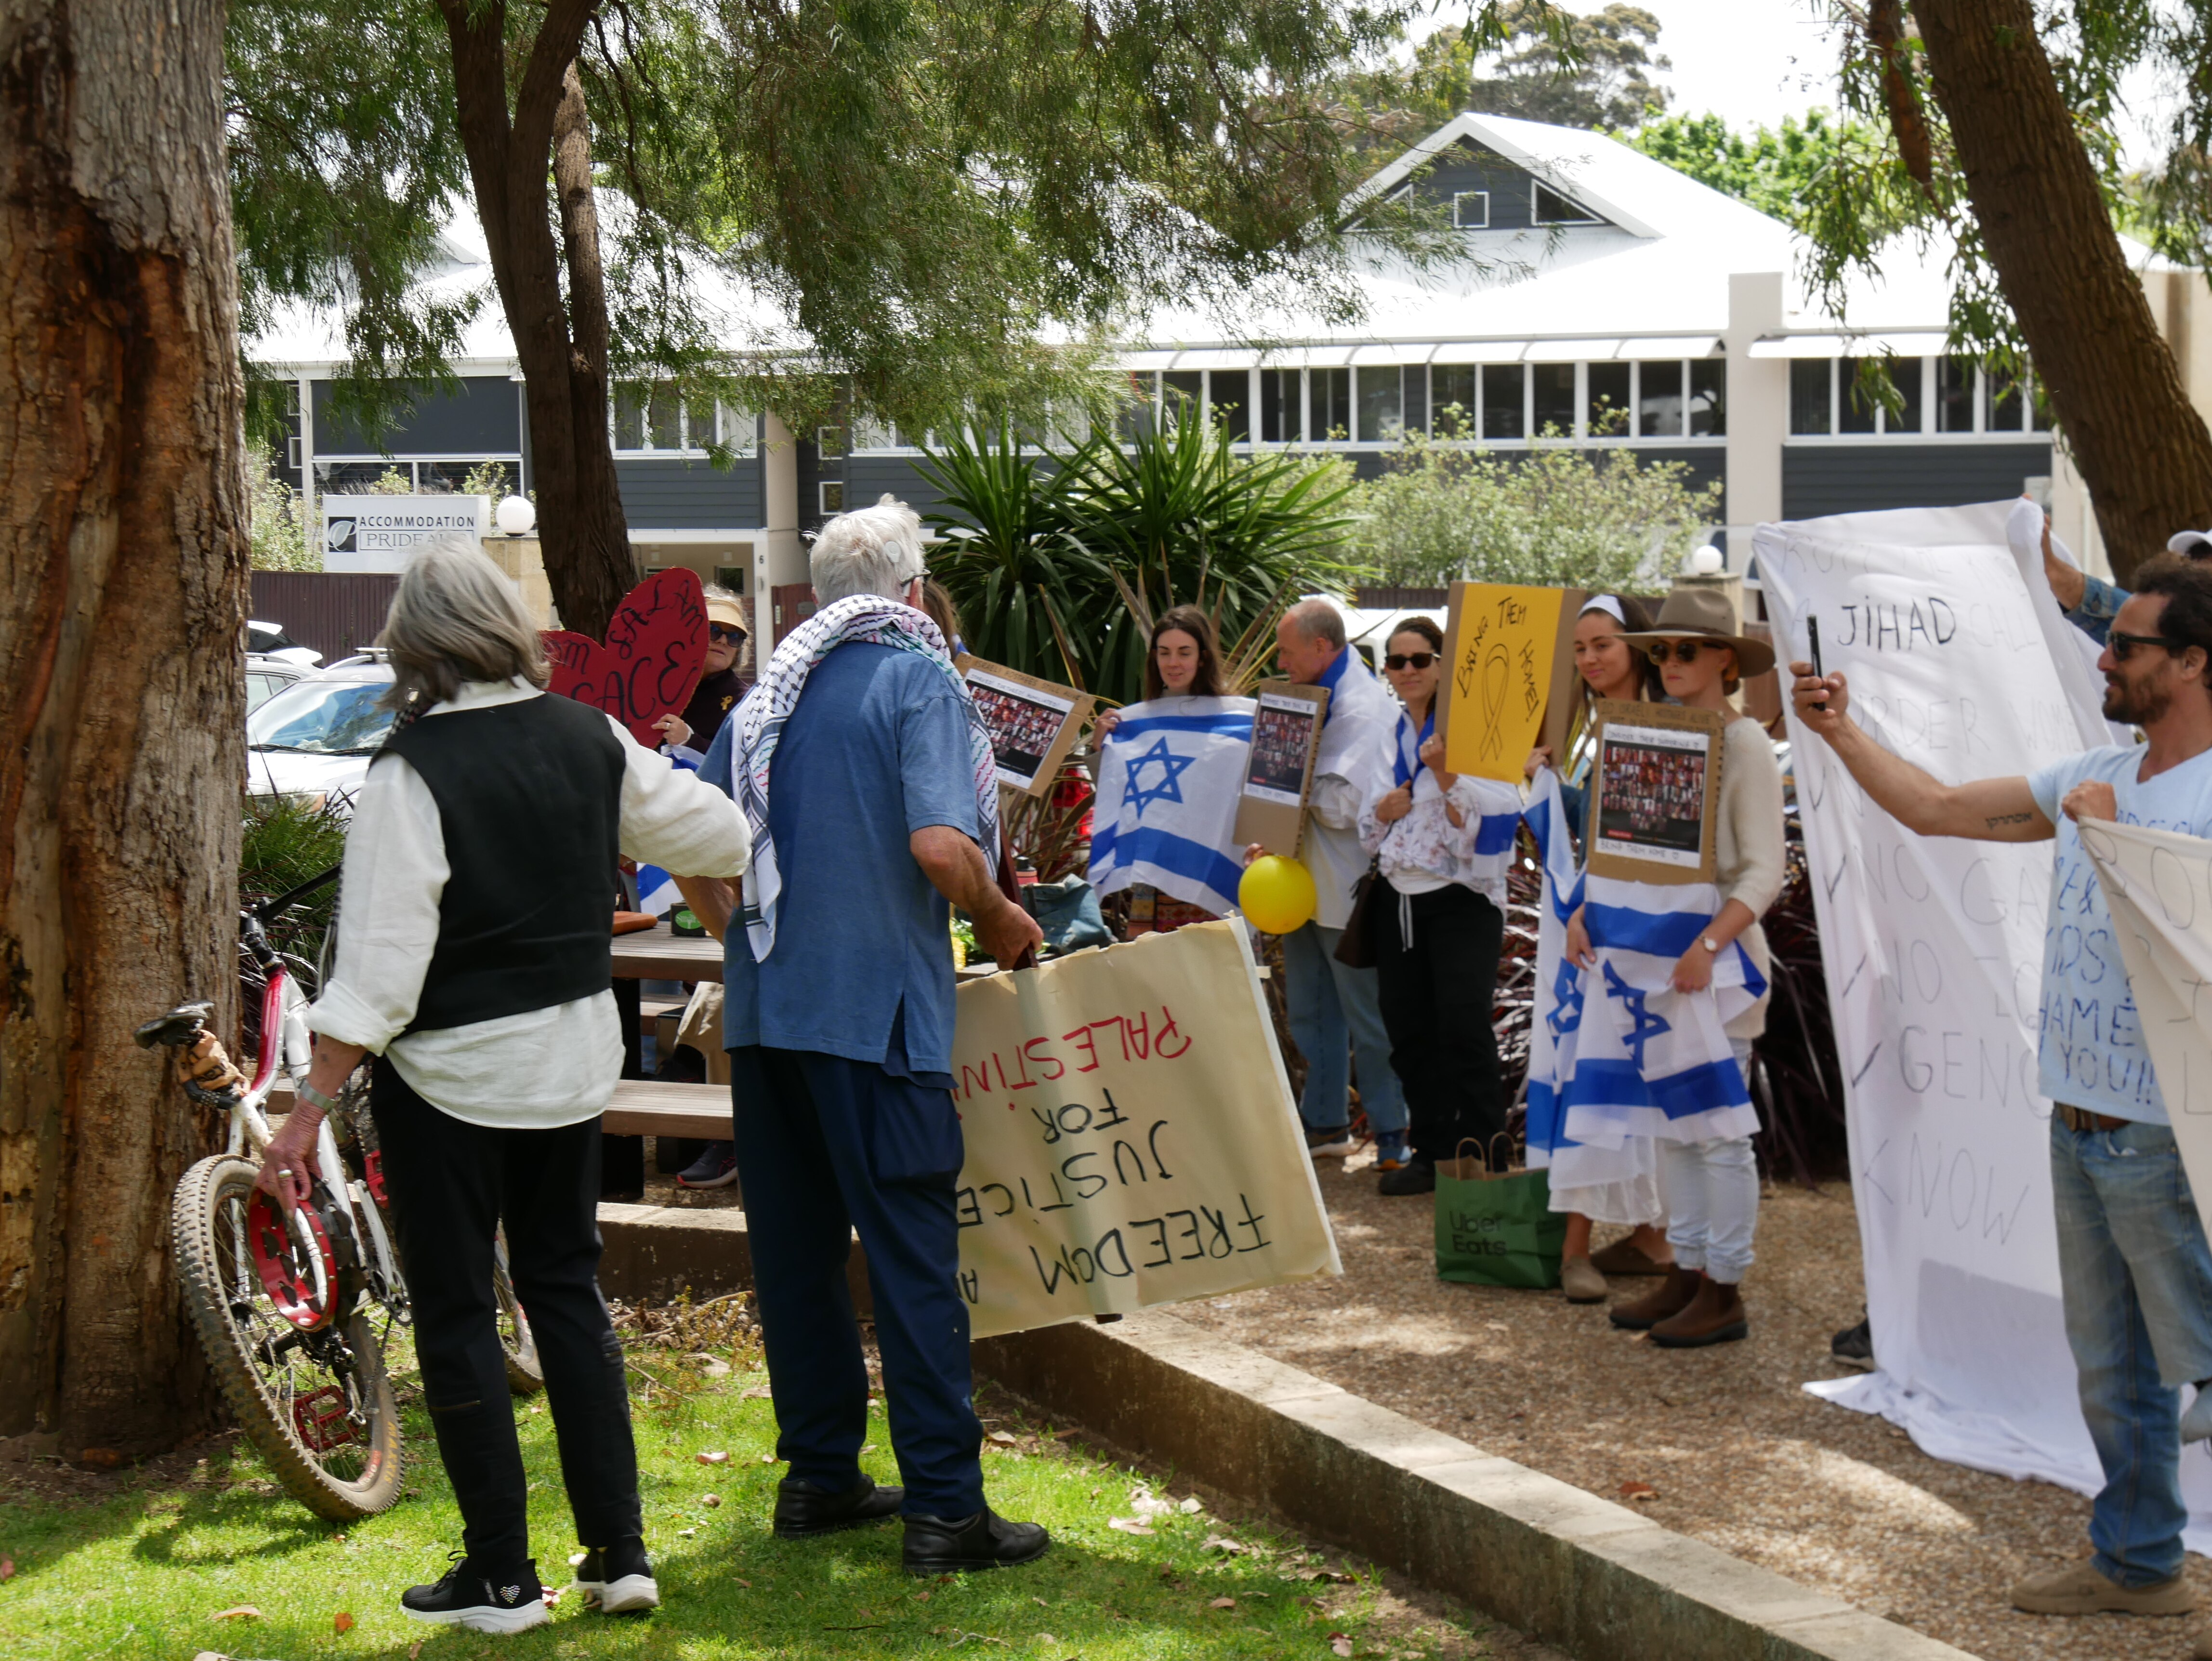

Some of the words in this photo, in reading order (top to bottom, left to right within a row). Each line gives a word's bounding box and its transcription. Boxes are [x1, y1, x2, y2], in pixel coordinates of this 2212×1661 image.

[360, 516, 474, 527] ACCOMMODATION
[759, 555, 764, 564] 6
[1032, 1087, 1130, 1144] FOR
[1448, 1211, 1502, 1233] Uber
[1029, 1193, 1272, 1294] FREEDOM
[1451, 1234, 1506, 1256] Eats
[384, 1421, 398, 1484] MAXXIS
